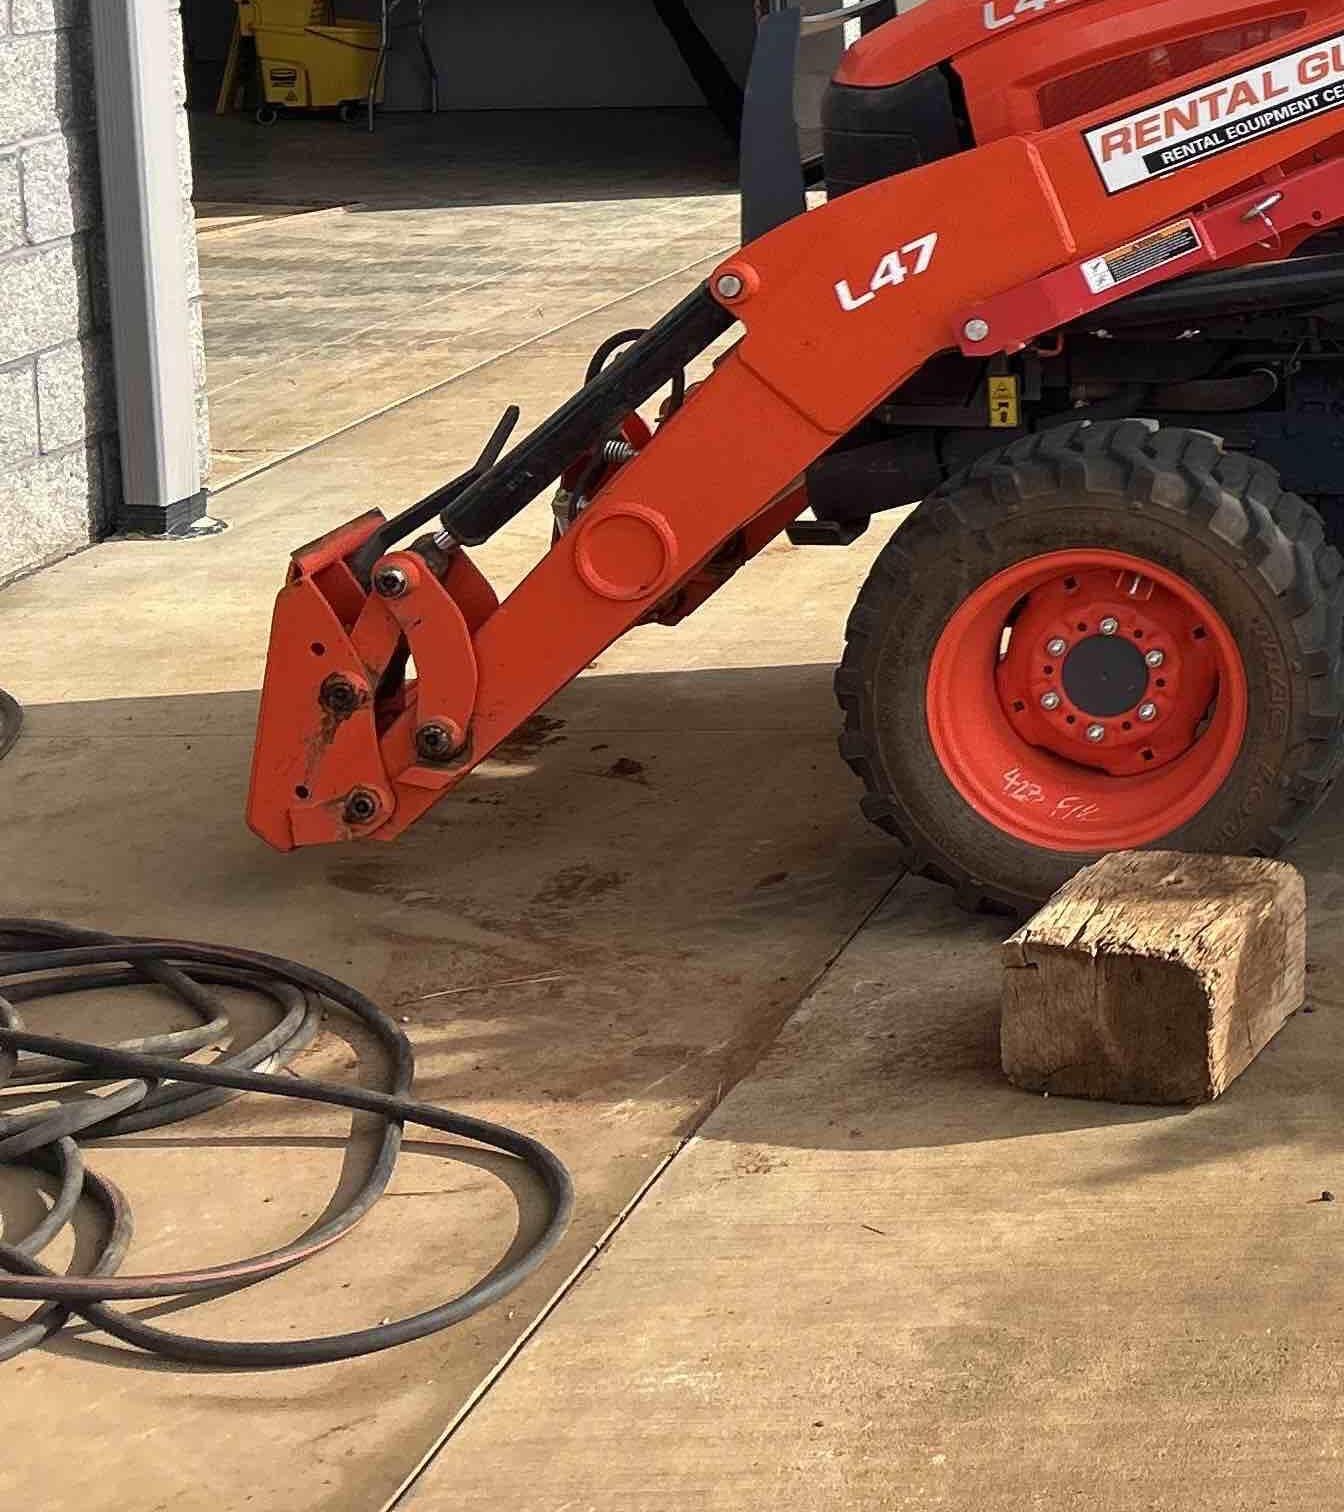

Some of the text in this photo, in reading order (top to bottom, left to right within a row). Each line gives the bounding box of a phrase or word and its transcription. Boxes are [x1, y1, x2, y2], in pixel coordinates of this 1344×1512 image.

[1101, 71, 1289, 162] RENTAL
[1161, 132, 1225, 165] RENTAL
[1226, 96, 1320, 140] EQUIPMENT
[834, 231, 939, 311] L47
